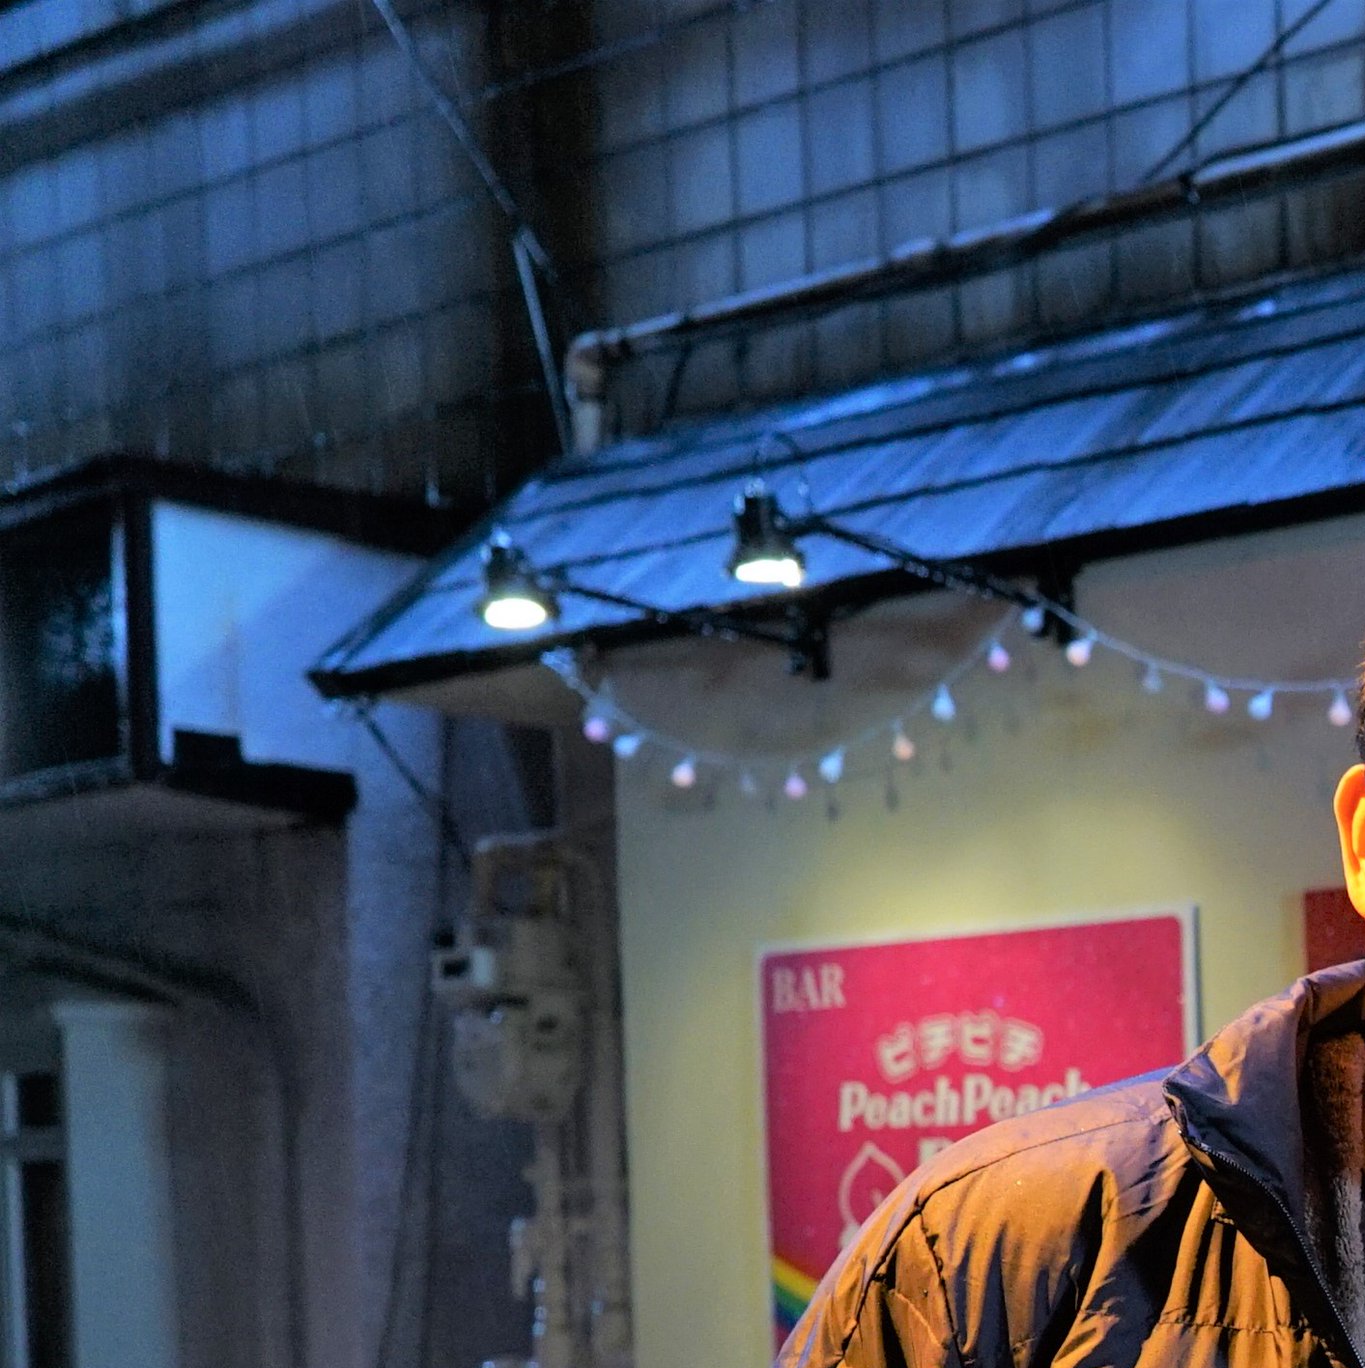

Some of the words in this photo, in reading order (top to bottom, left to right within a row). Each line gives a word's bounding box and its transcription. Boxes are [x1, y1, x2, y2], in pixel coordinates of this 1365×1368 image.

[774, 962, 847, 1014] BAR
[875, 1008, 1045, 1085] ピチピチ
